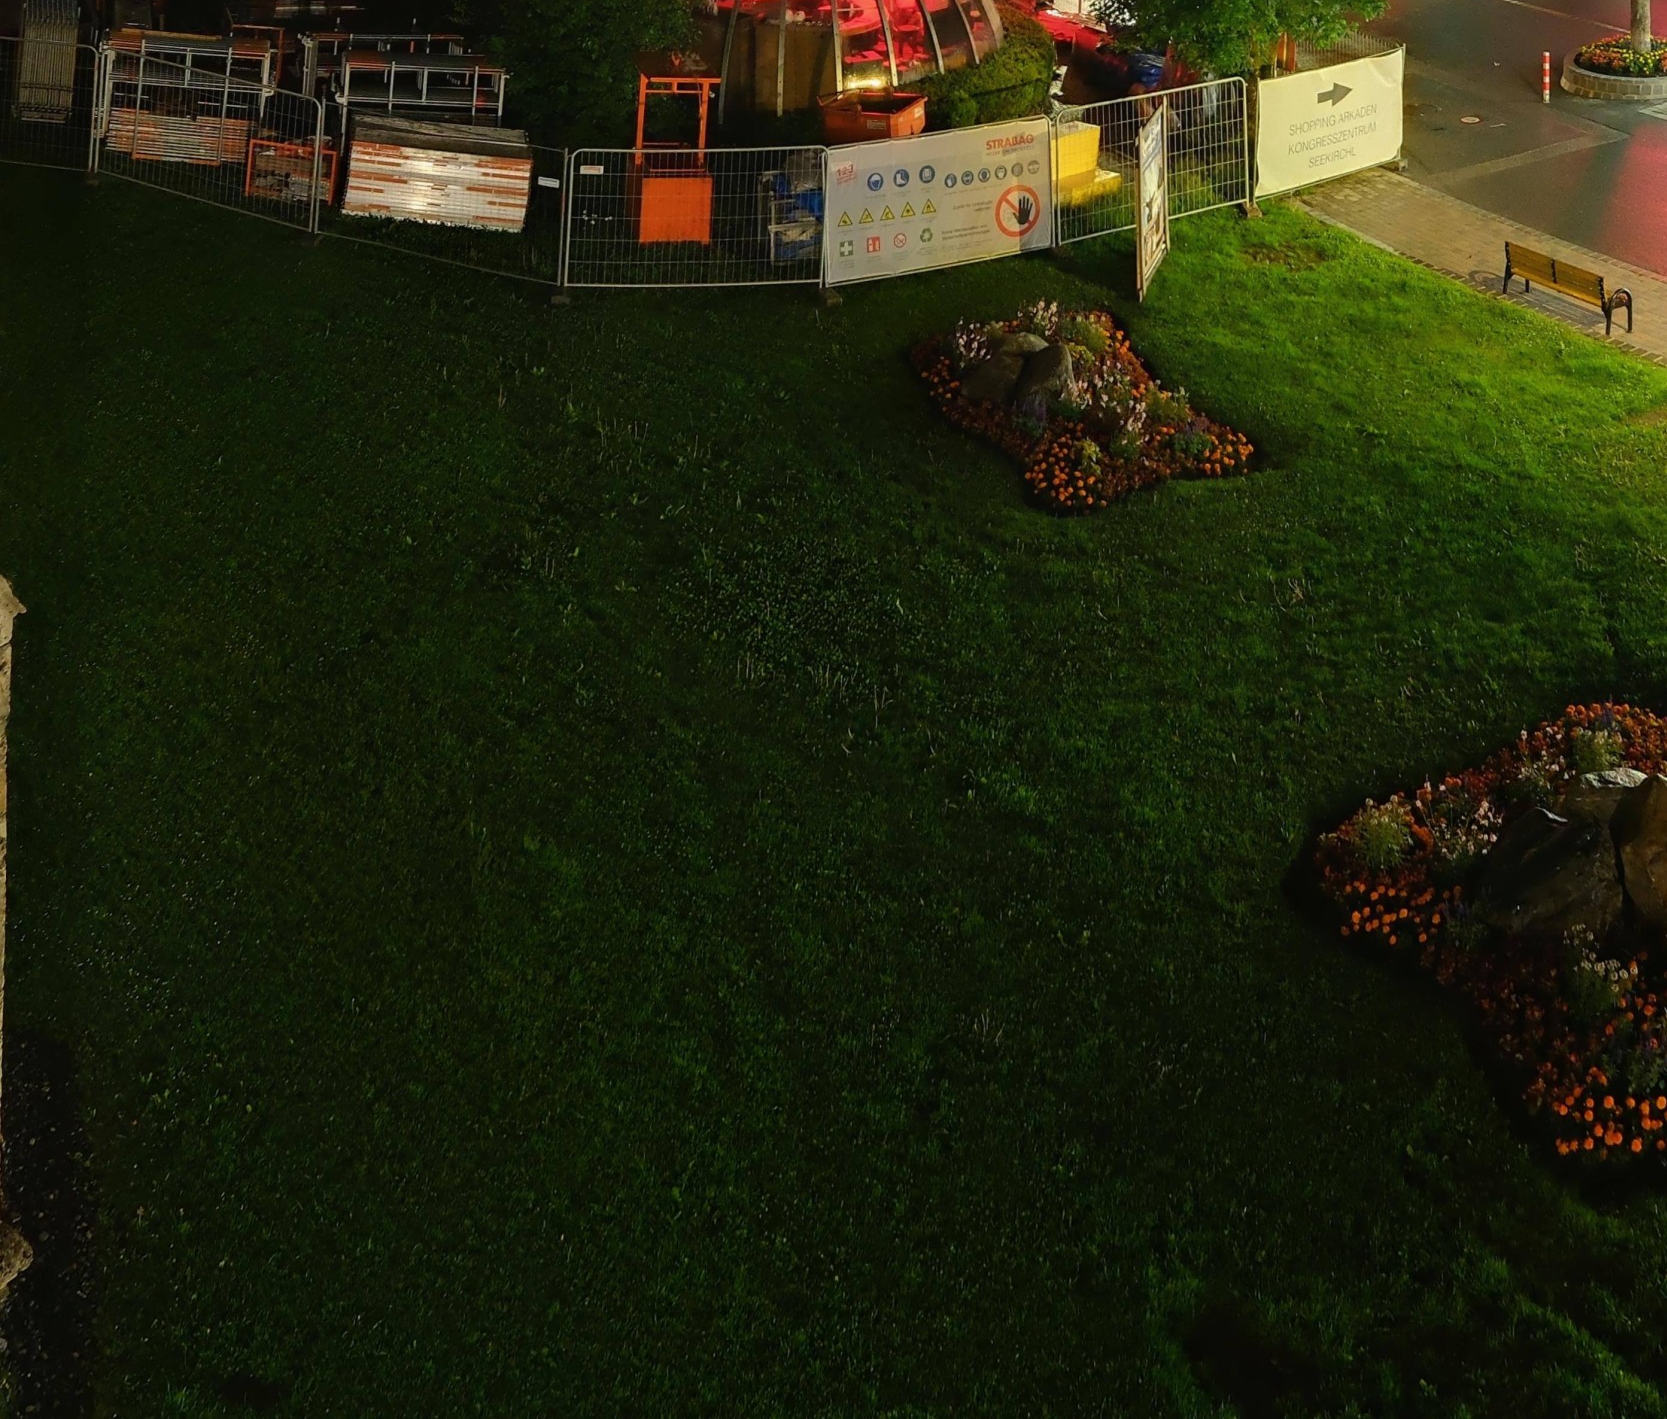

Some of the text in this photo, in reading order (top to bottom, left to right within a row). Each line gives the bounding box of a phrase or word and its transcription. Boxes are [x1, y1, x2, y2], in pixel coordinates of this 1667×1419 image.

[1288, 103, 1378, 137] SHOPPING ARKADEN
[986, 133, 1034, 151] STRABAG
[1287, 121, 1378, 156] KONGRESSZENTRUM
